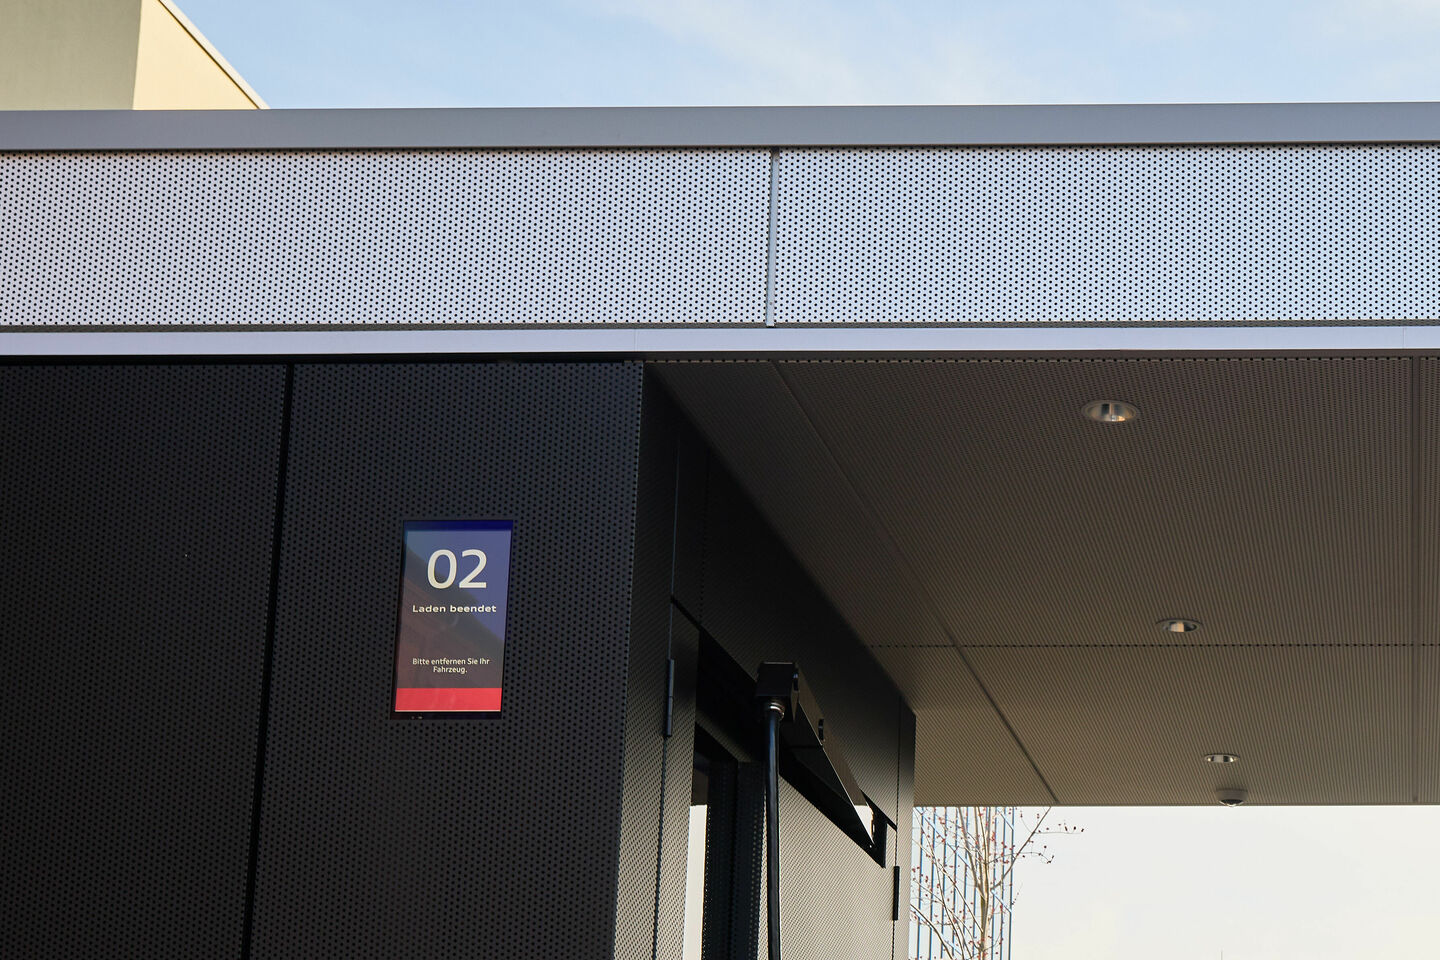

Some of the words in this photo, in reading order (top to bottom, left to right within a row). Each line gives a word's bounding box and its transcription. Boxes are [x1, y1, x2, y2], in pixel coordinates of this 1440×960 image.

[427, 549, 487, 589] 02
[412, 605, 446, 613] Laden
[449, 605, 497, 613] beendet
[433, 666, 468, 675] Fahrzeug.
